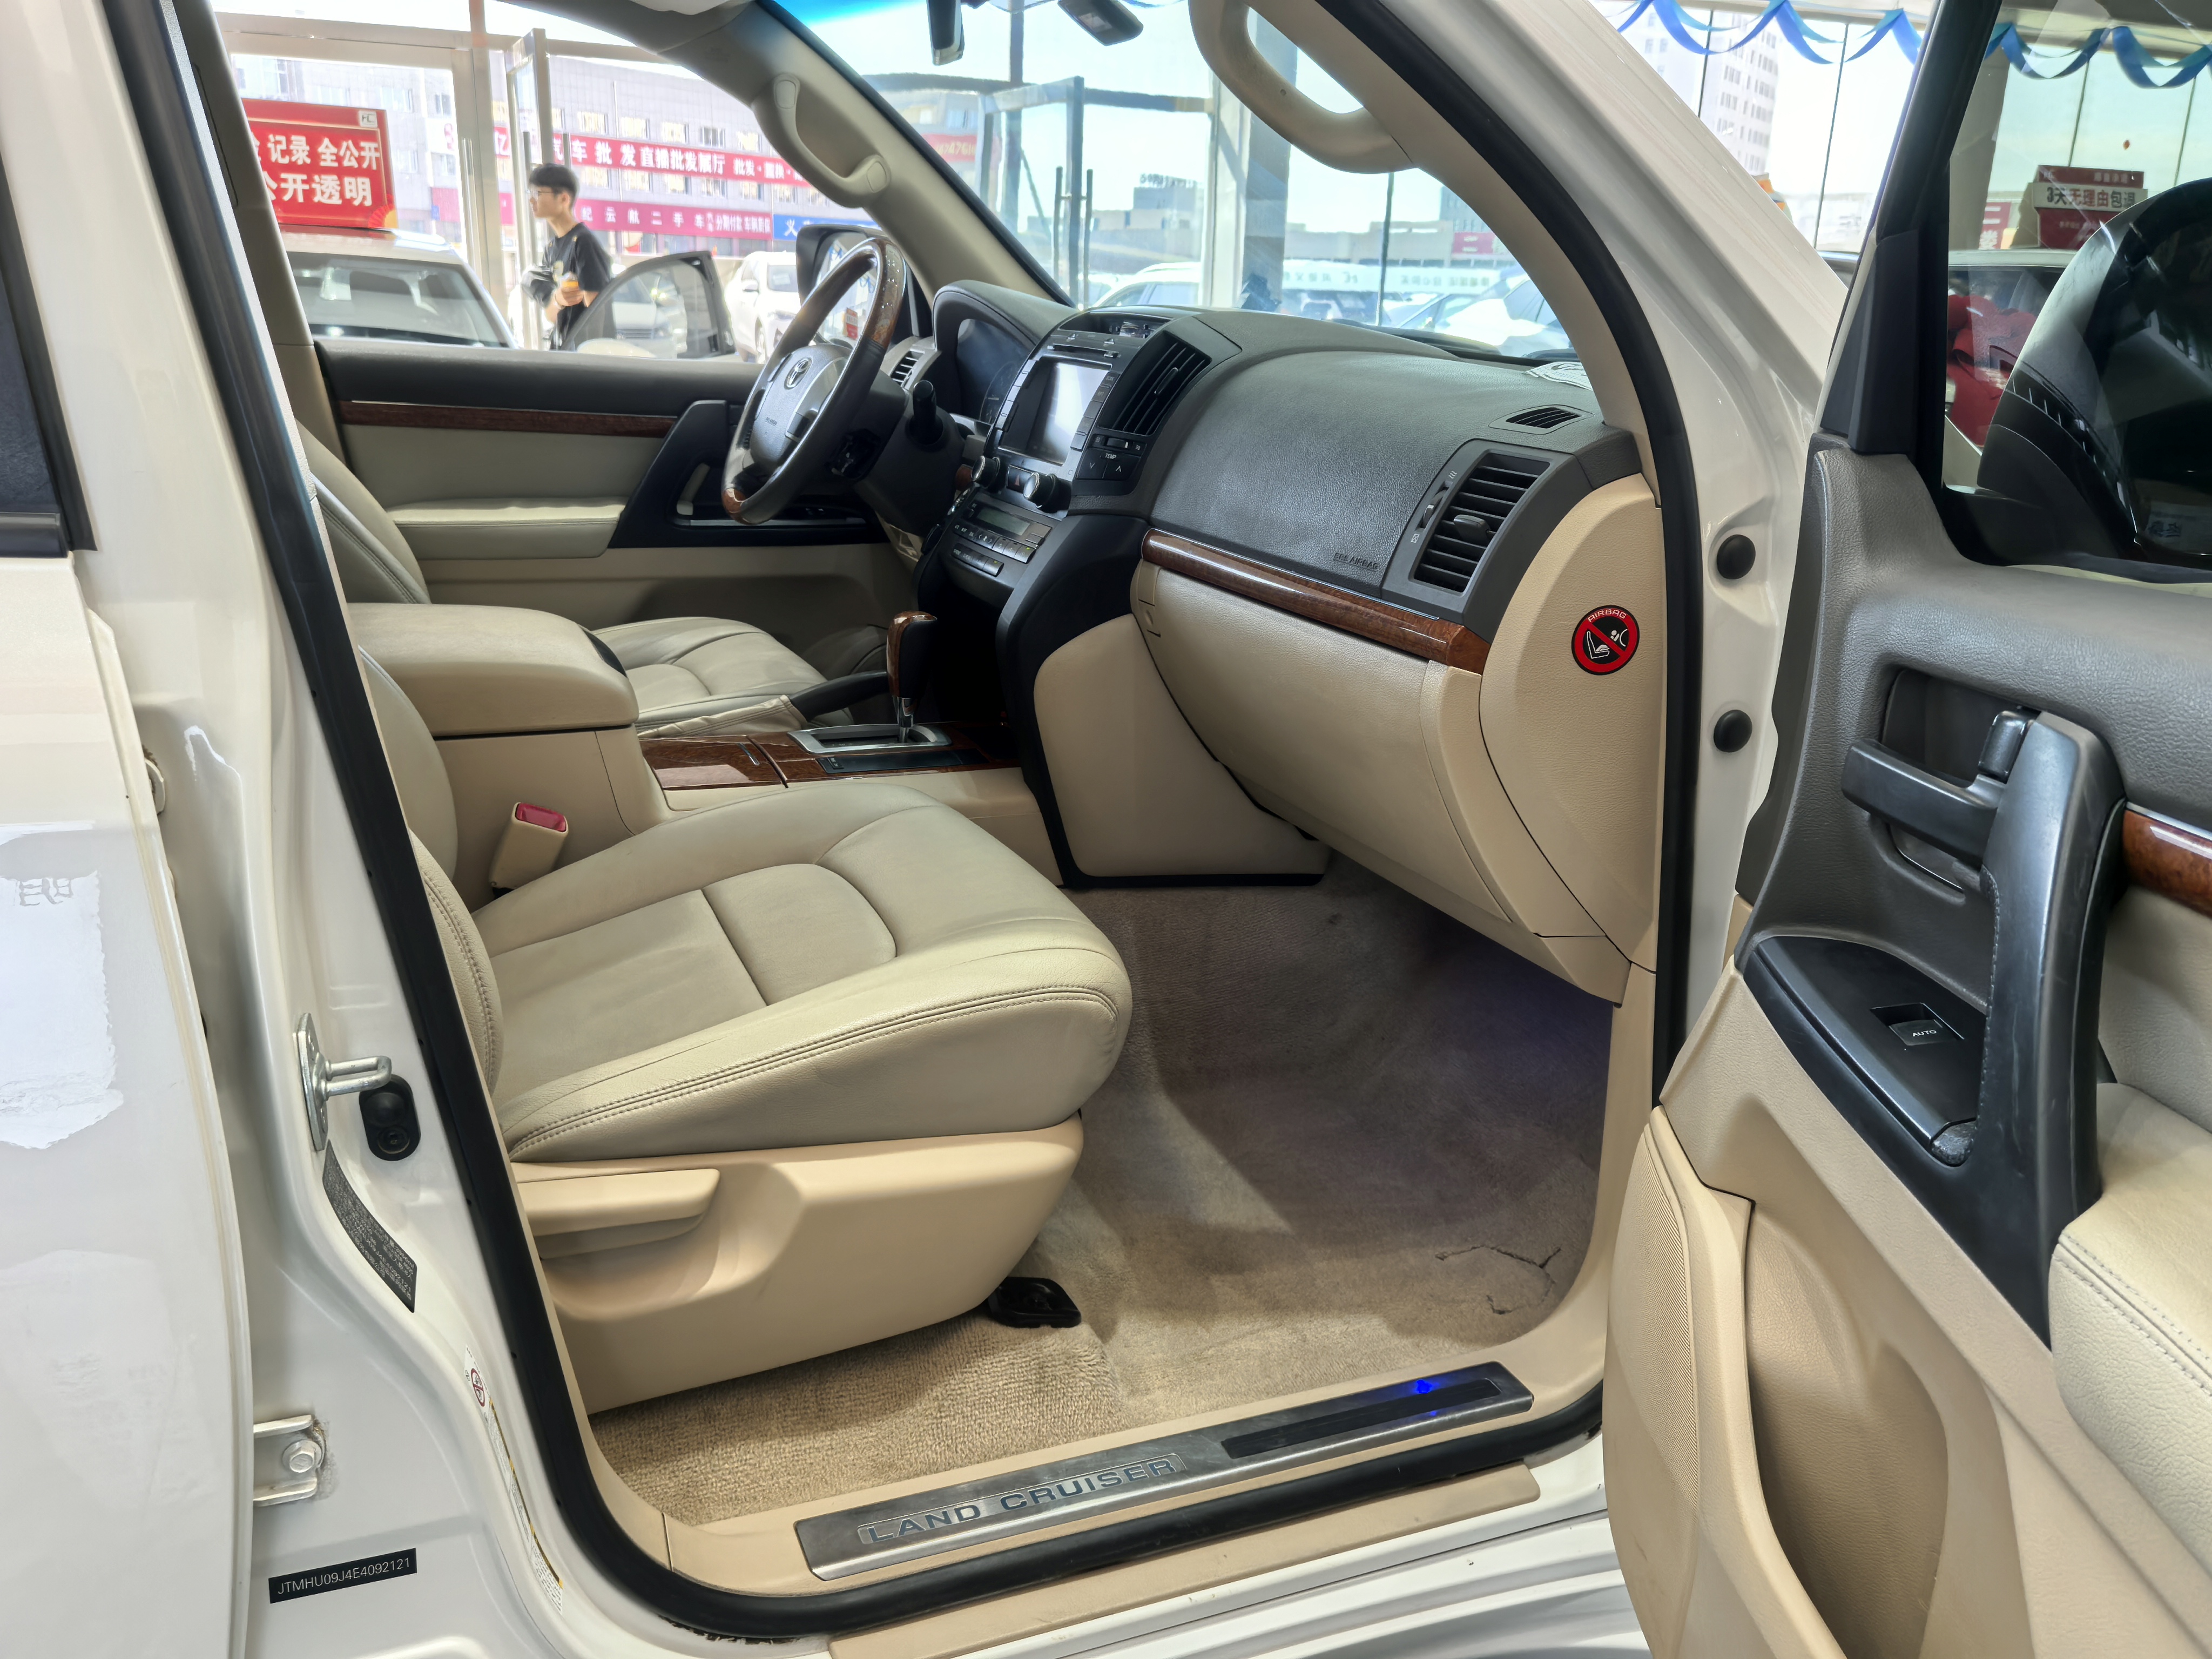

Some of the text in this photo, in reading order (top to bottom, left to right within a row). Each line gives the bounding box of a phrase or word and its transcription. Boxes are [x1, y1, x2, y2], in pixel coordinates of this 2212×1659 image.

[268, 133, 311, 165] 记录
[318, 137, 380, 170] 全公开
[1588, 609, 1627, 622] AIRBAG
[867, 1459, 1177, 1542] LAND CRUISER
[278, 1557, 410, 1594] JTMHU09J4E4092121
